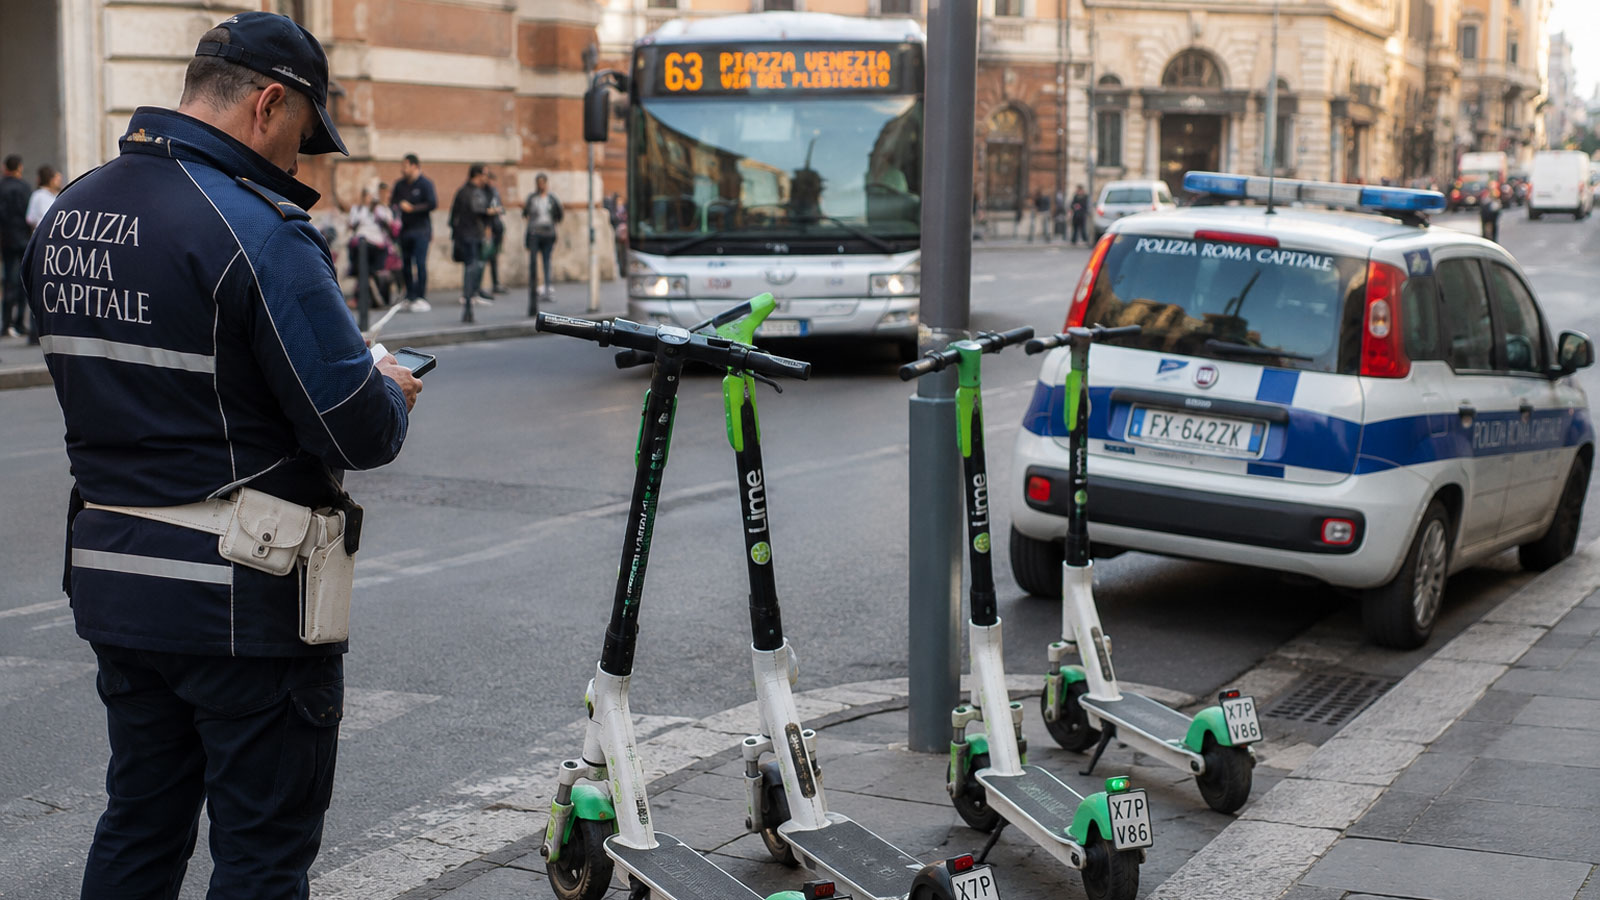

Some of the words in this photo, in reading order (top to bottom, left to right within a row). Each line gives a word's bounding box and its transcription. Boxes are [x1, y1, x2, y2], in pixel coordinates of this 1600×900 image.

[665, 52, 703, 91] 63
[719, 51, 796, 73] PIAZZA
[804, 50, 891, 72] VENEZIA
[720, 73, 752, 90] VIA
[757, 72, 786, 89] DEL
[792, 70, 890, 89] PLEBISCITO
[48, 209, 139, 247] POLIZIA
[42, 244, 114, 281] ROMA
[1135, 237, 1198, 256] POLIZIA
[1201, 243, 1251, 261] ROMA
[1256, 249, 1334, 271] CAPITALE
[42, 281, 152, 325] CAPITALE
[746, 468, 767, 533] Lime
[971, 472, 989, 527] Lime
[1226, 702, 1252, 720] X7P
[1231, 721, 1258, 739] V86
[1112, 798, 1144, 820] X7P
[1117, 823, 1148, 845] V86
[956, 875, 990, 900] X7P
